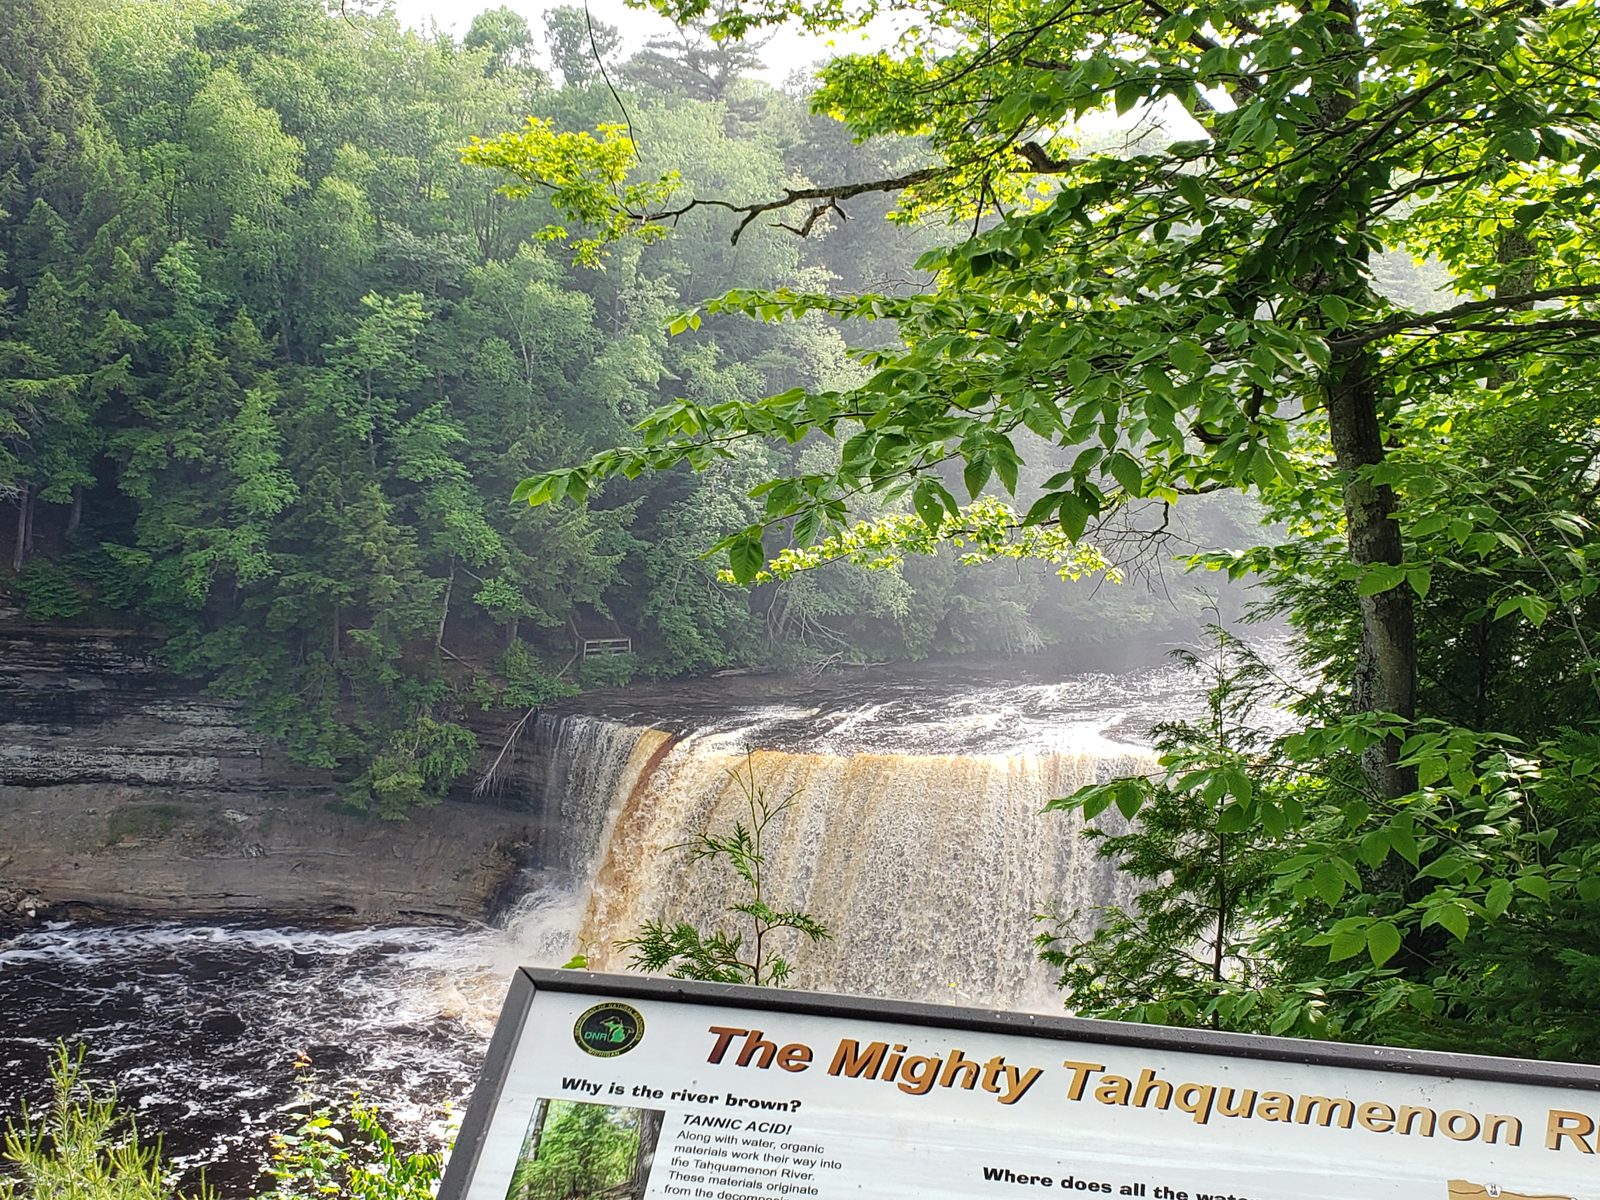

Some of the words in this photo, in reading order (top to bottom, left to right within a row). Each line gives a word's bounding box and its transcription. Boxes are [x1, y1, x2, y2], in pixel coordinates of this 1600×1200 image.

[584, 1031, 608, 1041] DNR
[562, 1077, 603, 1096] Why
[608, 1082, 625, 1095] is
[632, 1085, 664, 1099] the
[671, 1089, 719, 1104] river
[725, 1093, 802, 1113] brown?
[706, 1025, 813, 1073] The
[827, 1038, 1044, 1105] Mighty
[1062, 1060, 1523, 1147] Tahquamenon
[682, 1114, 742, 1130] TANNIC
[745, 1120, 792, 1135] ACID!
[676, 1130, 711, 1144] Along
[714, 1133, 738, 1145] with
[741, 1137, 776, 1150] water,
[780, 1142, 825, 1155] organic
[671, 1157, 689, 1167] the
[694, 1159, 777, 1177] Tahquamenon
[781, 1168, 815, 1181] River.
[673, 1144, 728, 1158] materials
[731, 1150, 759, 1161] work
[763, 1153, 790, 1164] their
[792, 1158, 817, 1169] way
[820, 1158, 842, 1170] into
[664, 1184, 691, 1197] from
[695, 1187, 718, 1199] the
[669, 1170, 704, 1183] These
[708, 1176, 763, 1190] materials
[766, 1182, 819, 1196] originate
[983, 1167, 1053, 1187] Where
[1060, 1175, 1112, 1194] does
[1119, 1182, 1146, 1197] all
[1153, 1186, 1189, 1200] the
